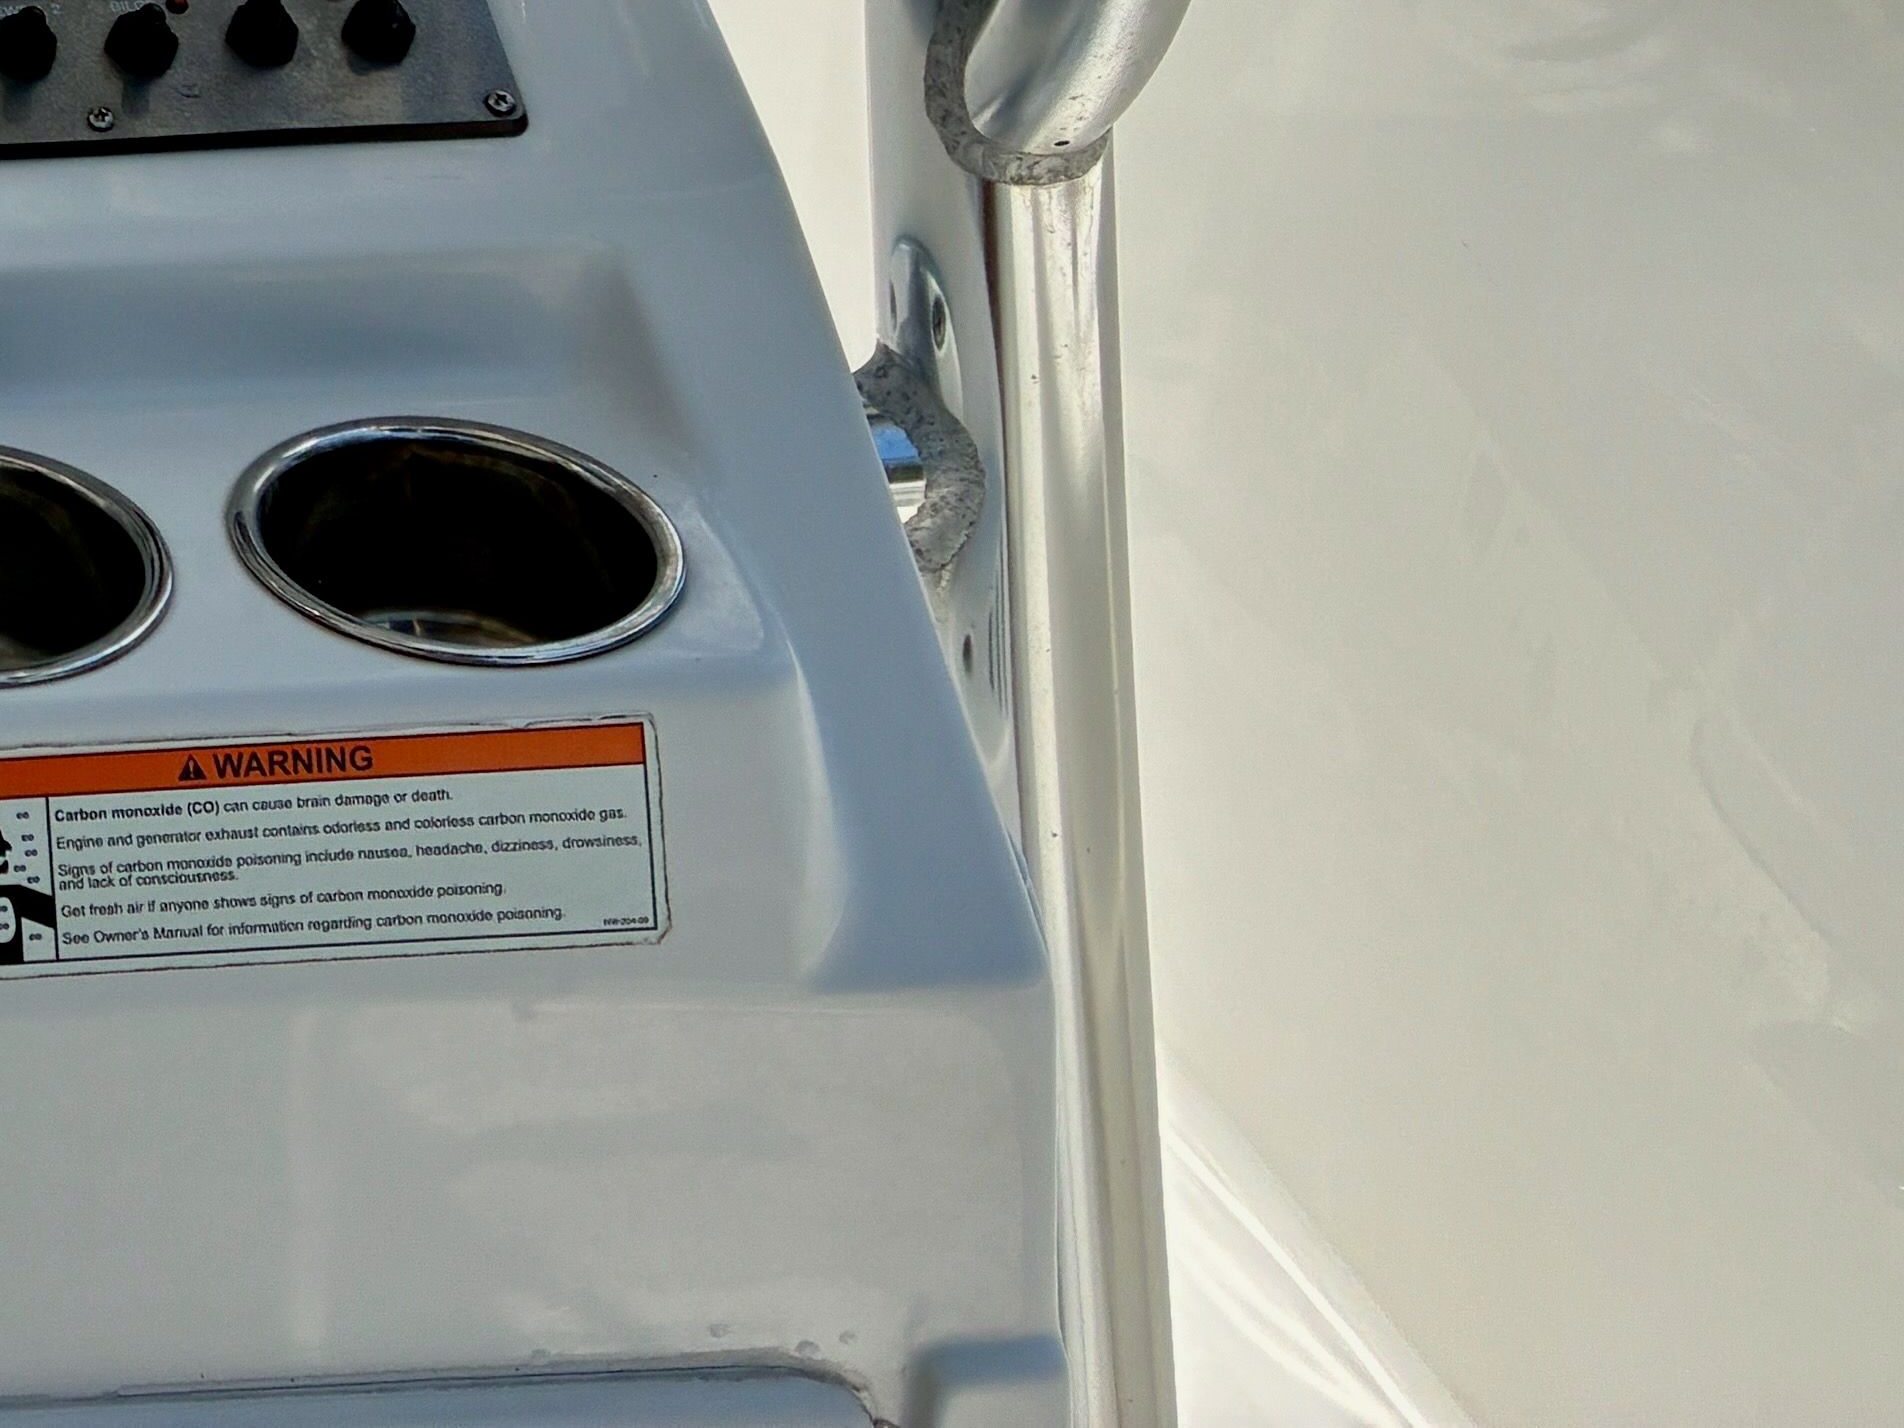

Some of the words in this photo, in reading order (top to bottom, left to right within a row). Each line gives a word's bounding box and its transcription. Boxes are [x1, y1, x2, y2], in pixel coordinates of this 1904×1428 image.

[214, 745, 373, 779] WARNING
[55, 808, 107, 823] Carbon
[111, 804, 183, 820] monoxide
[187, 800, 219, 817] (CO)
[224, 802, 248, 814] can
[252, 799, 292, 812] cause
[297, 795, 331, 809] brain
[335, 793, 389, 808] damage
[393, 792, 408, 803] or
[411, 788, 453, 803] death.
[56, 835, 103, 852] Engine
[107, 833, 133, 847] and
[136, 830, 202, 848] generator
[205, 827, 259, 842] exhaust
[262, 822, 320, 838] contains
[323, 820, 381, 835] odorless
[385, 817, 410, 831] and
[414, 815, 475, 830] colorless
[478, 812, 526, 827] carbon
[529, 808, 596, 824] monoxide
[599, 807, 627, 823] gas.
[58, 862, 96, 878] Signs
[100, 861, 113, 875] of
[116, 858, 163, 874] carbon
[167, 855, 233, 871] monoxide
[236, 852, 302, 869] poisoning
[305, 849, 354, 863] include
[358, 847, 412, 860] nausea,
[415, 841, 488, 857] headache,
[491, 838, 559, 854] dizziness,
[562, 834, 642, 850] drowsiness,
[59, 877, 85, 892] and
[88, 874, 116, 889] lack
[119, 874, 133, 887] of
[136, 870, 240, 887] consciousness.
[61, 904, 86, 919] Get
[89, 902, 124, 916] fresh
[127, 900, 144, 915] air
[147, 899, 157, 913] if
[160, 899, 210, 914] anyone
[213, 895, 257, 910] shows
[260, 892, 296, 909] signs
[299, 891, 314, 904] of
[317, 889, 364, 903] carbon
[367, 885, 434, 900] monoxide
[437, 882, 506, 899] poisoning.
[62, 930, 90, 946] See
[93, 927, 150, 944] Owner's
[153, 924, 204, 940] Manual
[207, 922, 225, 937] for
[228, 919, 304, 936] information
[308, 916, 372, 933] regarding
[376, 914, 423, 928] carbon
[426, 909, 494, 925] monoxide
[497, 907, 566, 923] poisoning.
